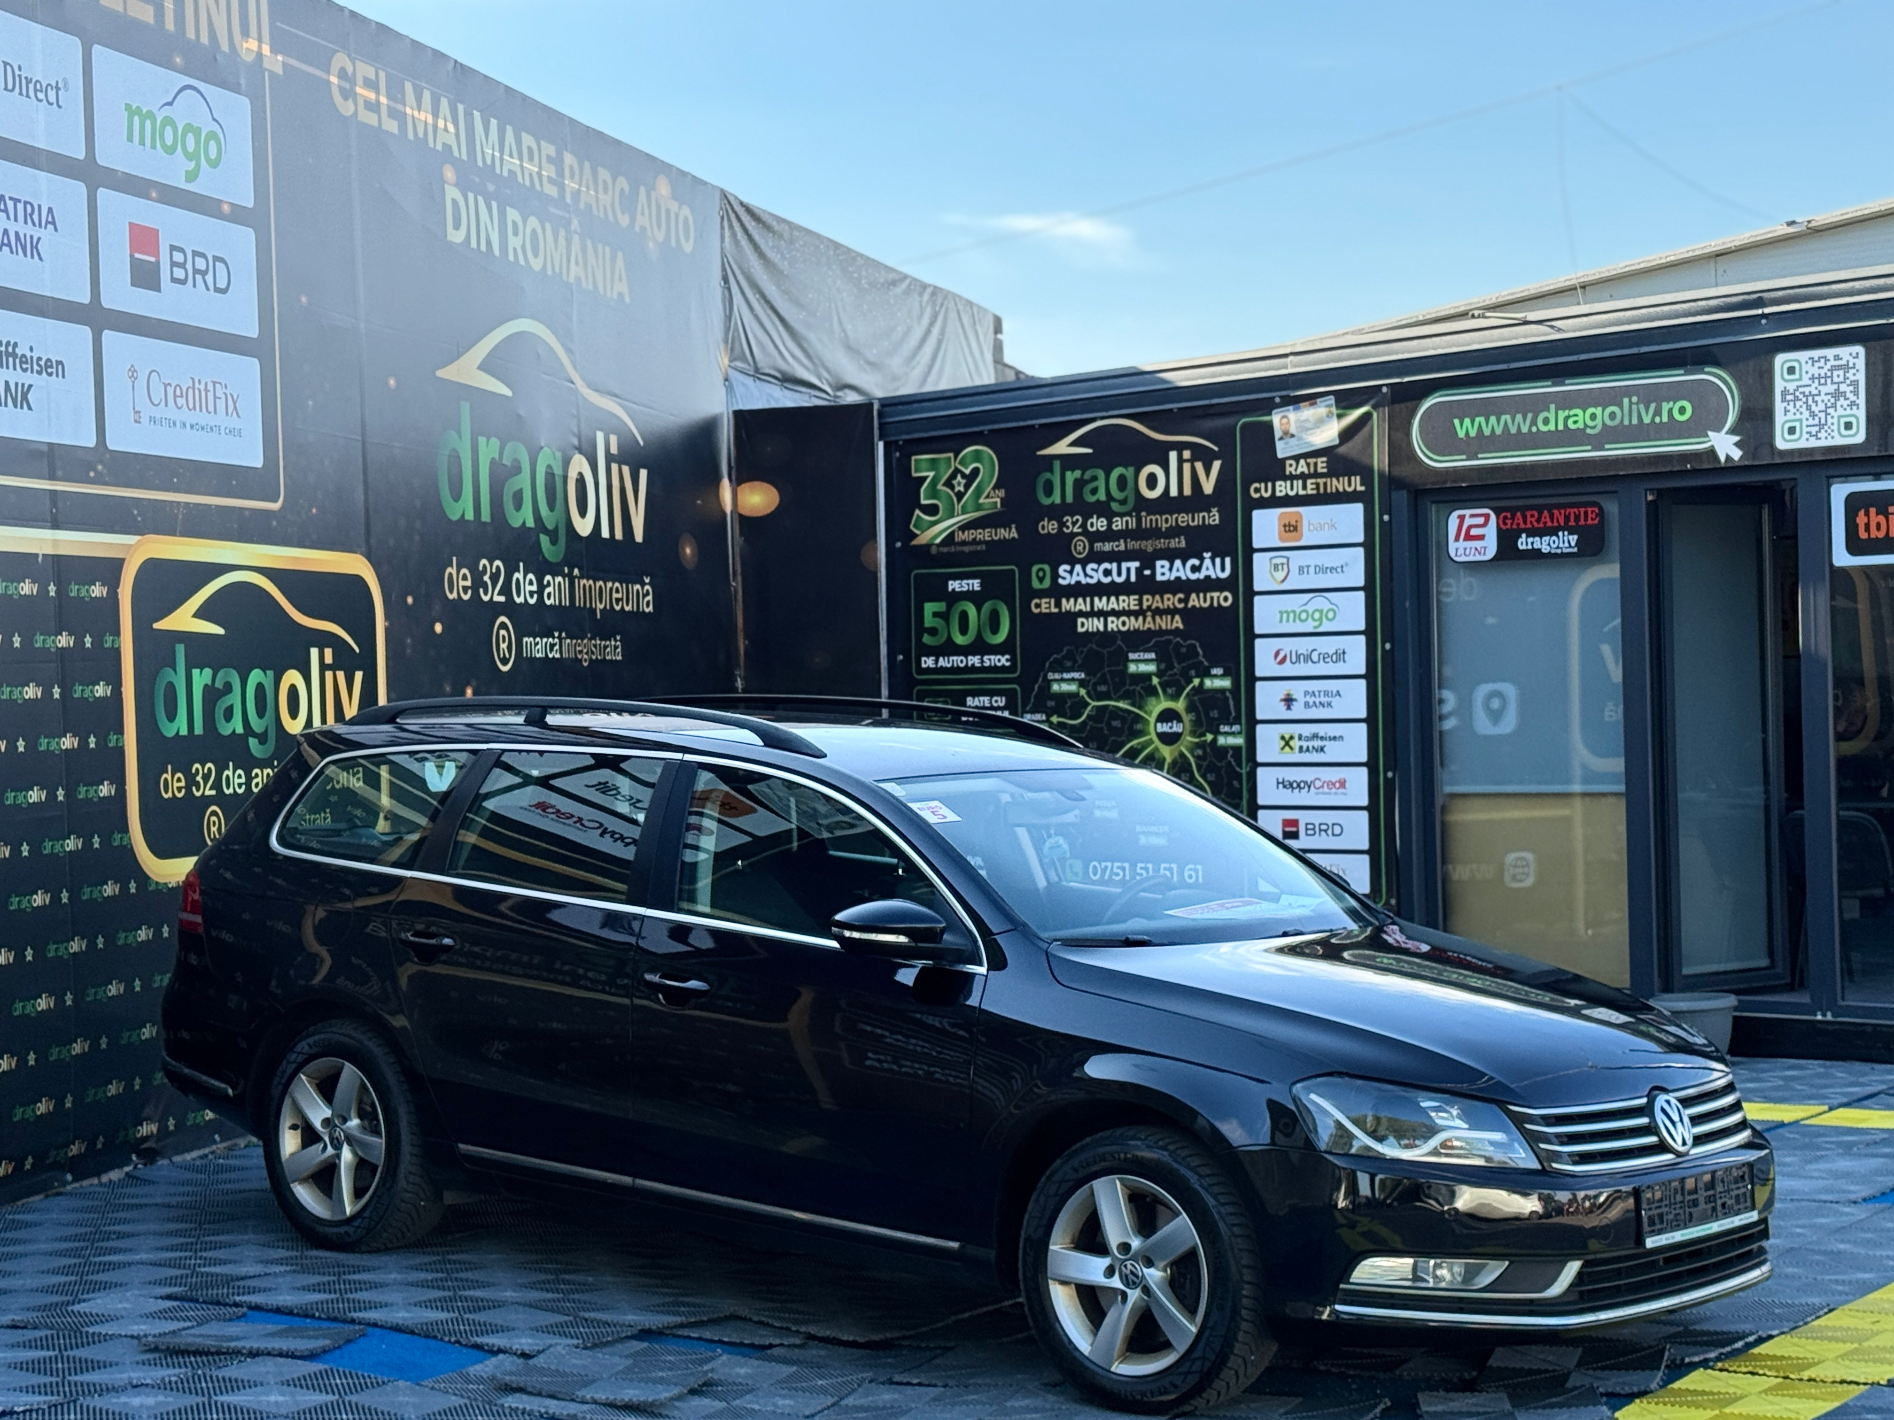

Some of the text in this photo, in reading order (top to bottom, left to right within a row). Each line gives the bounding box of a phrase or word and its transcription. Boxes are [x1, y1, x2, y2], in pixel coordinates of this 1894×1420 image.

[124, 102, 223, 183] mogo
[330, 52, 694, 254] CEL MAI MARE PARC AUTO
[444, 184, 630, 303] DIN ROMÂNIA
[169, 244, 231, 295] BRD
[0, 380, 34, 412] NK
[146, 369, 241, 418] CreditFix
[149, 415, 242, 438] PRIETEN IN MOMENTE CHEIE
[1453, 396, 1692, 439] www.dragoliv.ro
[1286, 457, 1327, 475] RATE
[438, 401, 648, 562] dragoliv
[910, 445, 1005, 535] 32 ANI
[1036, 450, 1222, 512] dragoliv
[1250, 476, 1365, 498] CU BULETINUL
[1038, 507, 1220, 534] de 32 de ani împreună
[1282, 519, 1337, 533] tbi bank
[1454, 513, 1490, 542] 12
[1498, 507, 1600, 530] GARANTIE
[1856, 506, 1894, 540] tbi
[955, 524, 1018, 542] ÎMPREUNĂ
[1094, 539, 1125, 551] marcă
[1127, 536, 1186, 552] înregistrată
[1518, 531, 1578, 553] dragoliv
[1454, 546, 1488, 558] LUNI
[1058, 562, 1140, 585] SASCUT
[1155, 552, 1231, 581] BACĂU
[1273, 562, 1286, 572] BT
[1298, 565, 1311, 576] BT
[68, 581, 108, 601] dragoliv
[444, 557, 653, 619] de 32 de ani împreună
[948, 579, 981, 592] PESTE
[1031, 592, 1233, 613] CEL MAI MARE PARC AUTO
[922, 599, 1010, 646] 500
[1077, 612, 1183, 632] DIN ROMÂNIA
[1279, 608, 1337, 629] mogo
[34, 631, 75, 652] dragoliv
[522, 631, 560, 659] marcă
[561, 632, 622, 666] înregistrată
[921, 655, 1010, 668] DE AUTO PE STOC
[1128, 652, 1156, 660] SUCEAVA
[1290, 648, 1347, 665] UniCredit
[0, 681, 112, 703] dragoliv dragoliv
[154, 644, 363, 759] dragoliv
[966, 696, 1005, 707] RATE CU
[1304, 690, 1342, 699] PATRIA
[1304, 700, 1333, 709] BANK
[1156, 720, 1183, 732] BACĂU
[38, 733, 79, 754] dragoliv
[1298, 734, 1344, 742] Raiffeisen
[1298, 745, 1326, 754] BANK
[160, 764, 185, 799] de
[192, 762, 216, 797] 32
[222, 761, 246, 794] de
[1276, 777, 1347, 793] HappyCredit
[4, 780, 116, 808] dragoliv dragoliv
[1305, 823, 1343, 837] BRD
[42, 835, 83, 856] dragoliv
[1089, 861, 1130, 880] 0751
[1136, 863, 1152, 880] 51
[1184, 864, 1202, 883] 61
[8, 890, 51, 912] dragoliv
[81, 880, 120, 902] dragoliv
[46, 936, 88, 958] dragoliv
[116, 925, 154, 946] dragoliv
[12, 980, 125, 1016] dragoliv dragoliv
[48, 1038, 90, 1062] dragoliv
[12, 1097, 56, 1122] dragoliv
